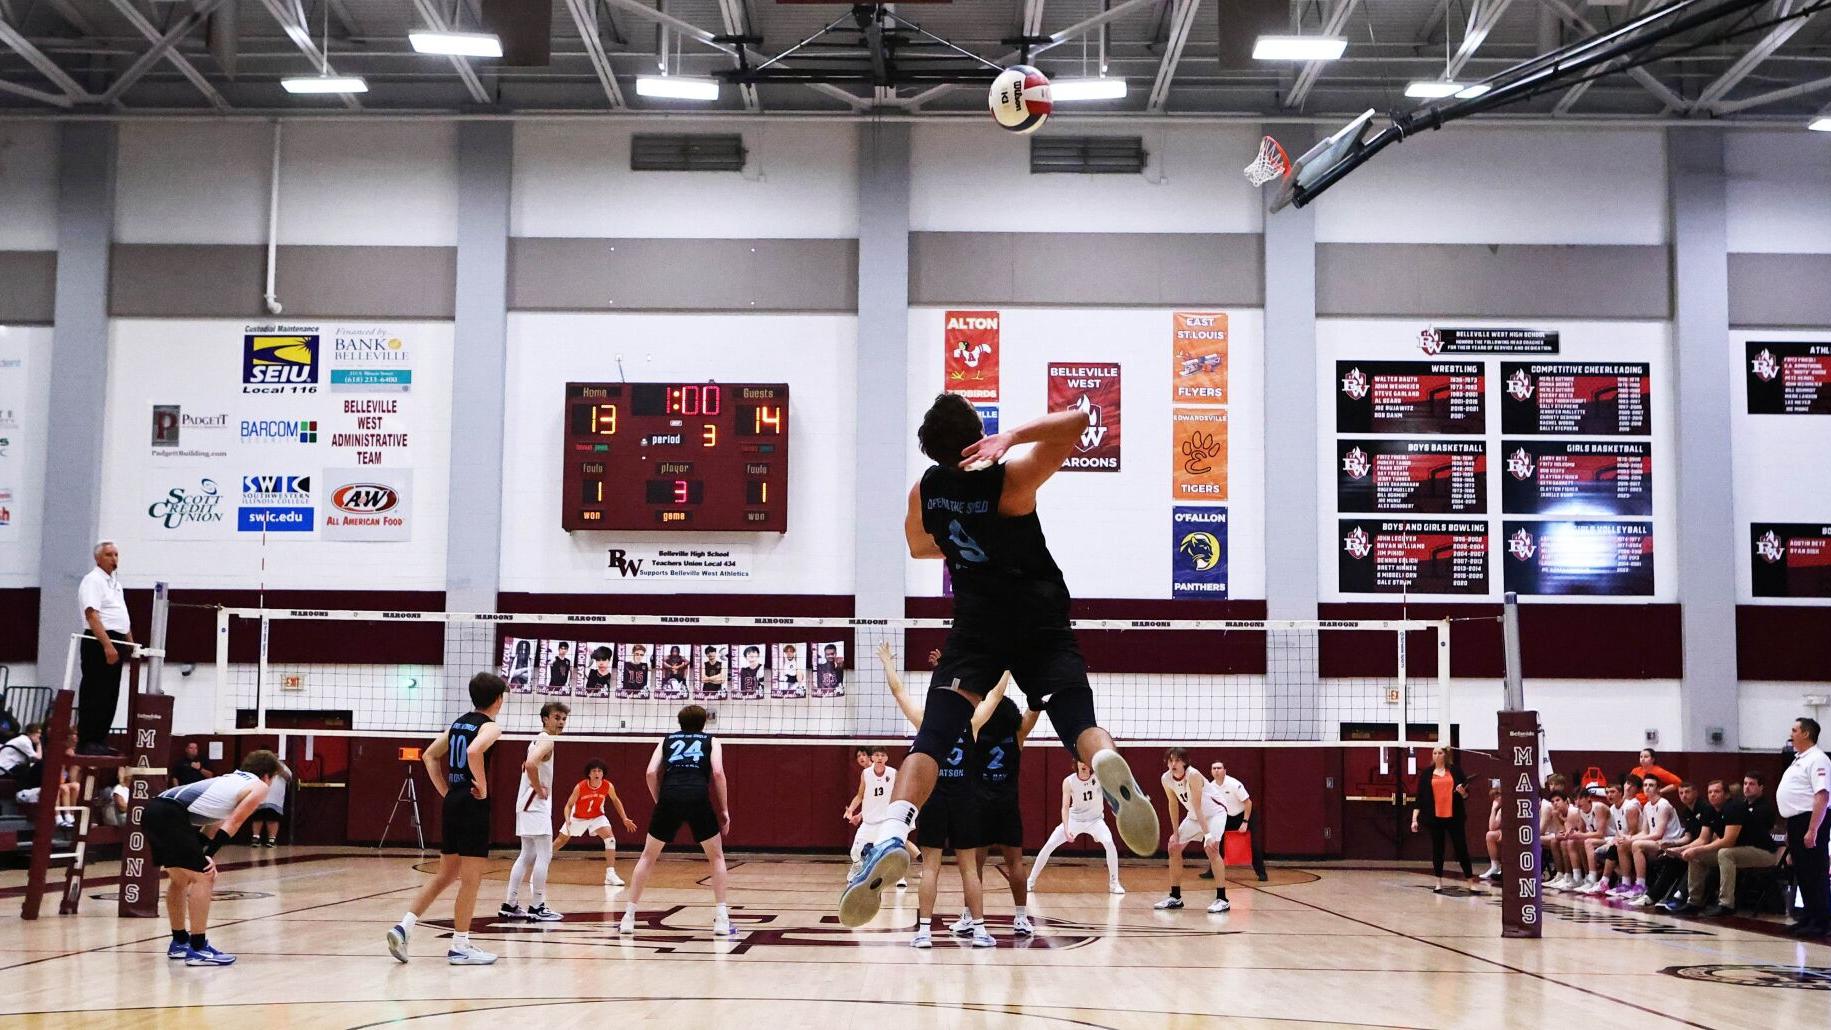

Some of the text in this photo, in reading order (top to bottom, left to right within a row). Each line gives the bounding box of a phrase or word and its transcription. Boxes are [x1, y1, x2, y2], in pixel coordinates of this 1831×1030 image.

[1014, 80, 1022, 111] Wilson
[947, 318, 998, 330] ALTON
[1186, 317, 1214, 327] EAST
[245, 325, 275, 333] Custodial
[335, 338, 386, 350] BANK
[335, 352, 409, 360] BELLEVILLE
[250, 365, 311, 383] SEIU
[1050, 368, 1118, 377] BELLEVILLE
[1431, 365, 1477, 373] WRESTLING
[1531, 365, 1643, 374] COMPETITIVE CHEERLEADING
[1067, 379, 1102, 388] WEST
[243, 386, 318, 394] Local 116
[583, 388, 607, 398] Home
[743, 388, 774, 399] Guests
[1178, 388, 1223, 397] FLYERS
[666, 385, 720, 416] 1:00
[344, 400, 397, 413] BELLEVILLE
[182, 414, 229, 425] PADGETT
[357, 417, 383, 429] WEST
[591, 404, 616, 435] 13
[755, 406, 780, 434] 14
[1174, 415, 1227, 423] EDWARDSVILLE
[241, 421, 298, 437] BARCOM
[331, 434, 408, 447] ADMINISTRATIVE
[652, 434, 681, 445] period
[703, 424, 716, 447] 3
[1408, 444, 1483, 452] BOYS BASKETBALL
[1567, 445, 1643, 453] GIRLS BASKETBALL
[357, 451, 382, 464] TEAM
[1061, 458, 1117, 468] AROONS
[660, 463, 689, 474] player
[243, 476, 311, 493] SWIC
[1181, 484, 1220, 494] TIGERS
[169, 488, 224, 504] SCOTT
[598, 481, 602, 502] 1
[674, 480, 687, 503] 3
[762, 482, 767, 503] 1
[148, 498, 217, 518] CREDIT
[163, 512, 224, 529] UNION
[249, 510, 303, 522] swic.edu
[583, 511, 601, 520] won
[663, 512, 685, 521] game
[748, 512, 765, 520] won
[1175, 513, 1226, 523] O'FALLON
[1382, 523, 1404, 531] BOYS
[1405, 523, 1422, 531] AND
[1448, 524, 1485, 532] BOWLING
[1174, 583, 1226, 592] PANTHERS
[450, 734, 467, 768] 10
[668, 740, 704, 763] 24
[987, 746, 1004, 769] 2
[939, 769, 964, 777] ATSON
[874, 787, 884, 796] 13
[1083, 791, 1093, 801] 17
